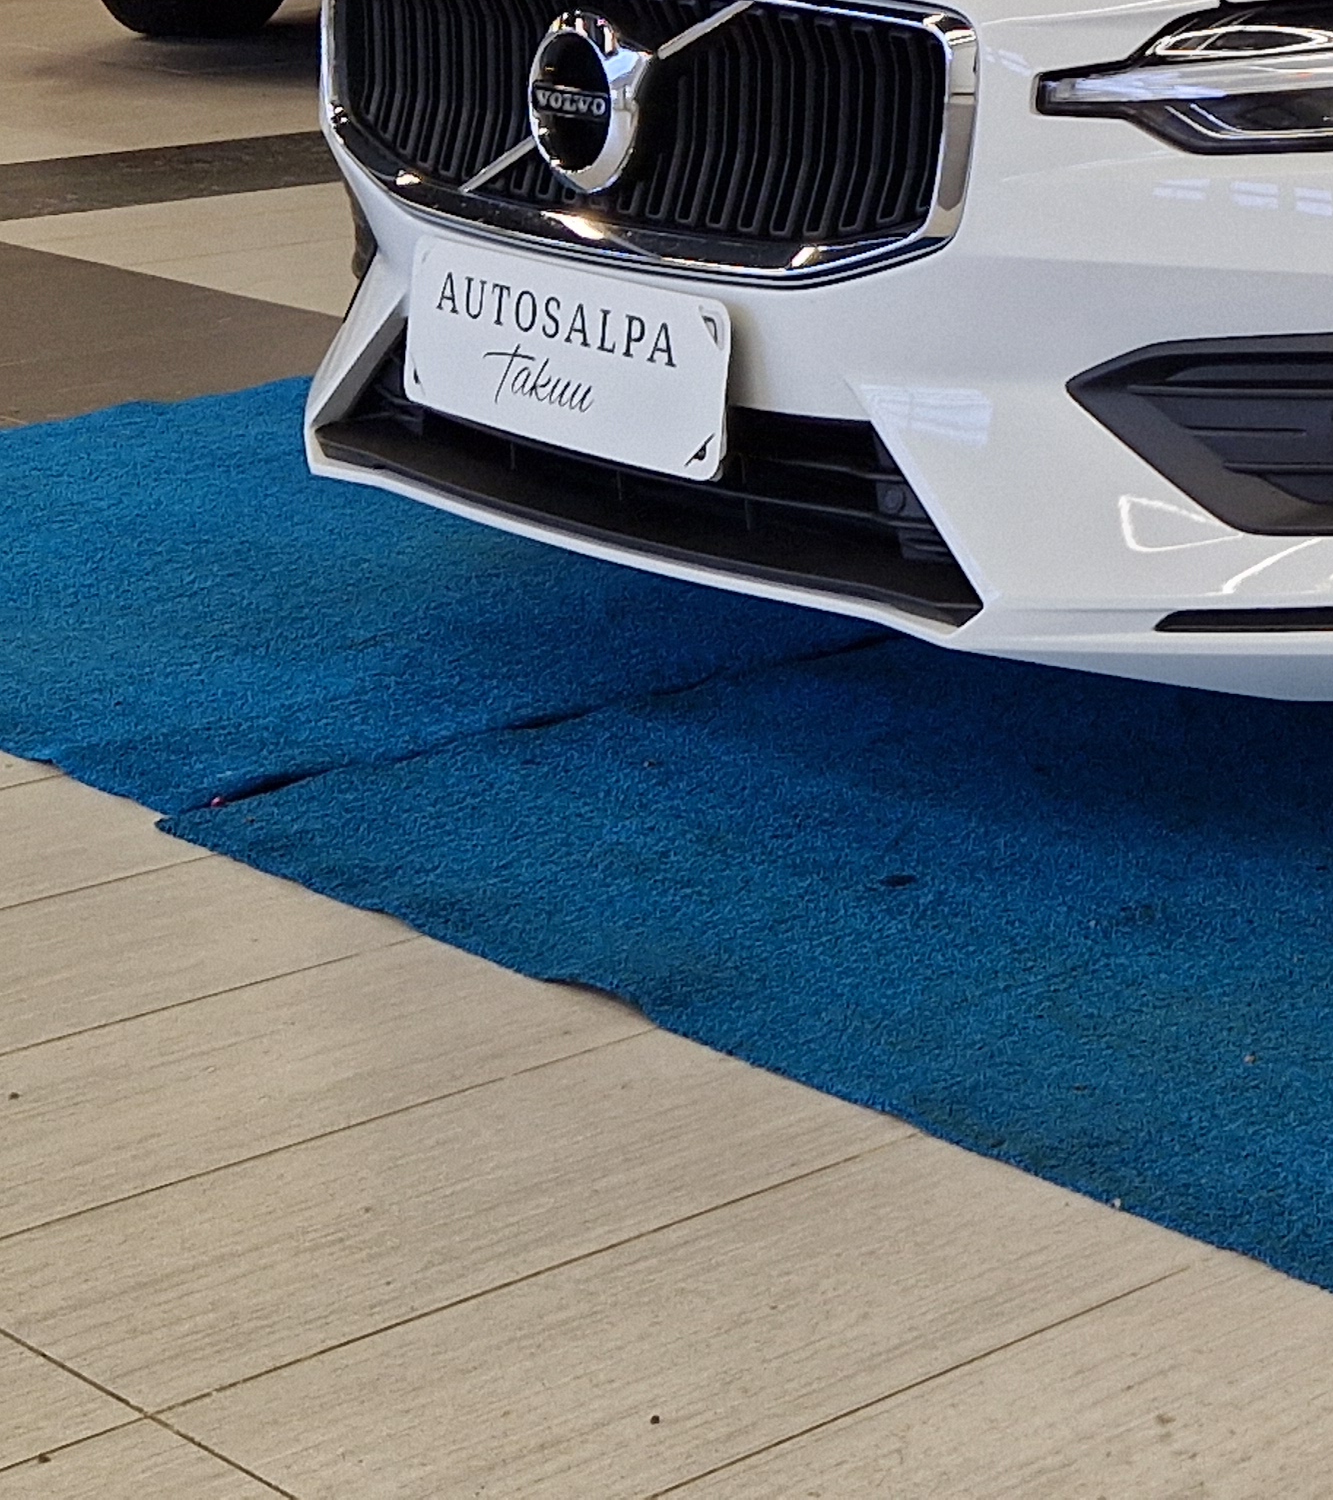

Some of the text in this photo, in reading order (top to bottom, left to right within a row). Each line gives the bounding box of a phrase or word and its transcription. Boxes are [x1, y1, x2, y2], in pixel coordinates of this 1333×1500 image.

[535, 89, 606, 117] VOLVO
[436, 271, 678, 368] AUTOSALPA
[483, 343, 595, 413] Takuu
